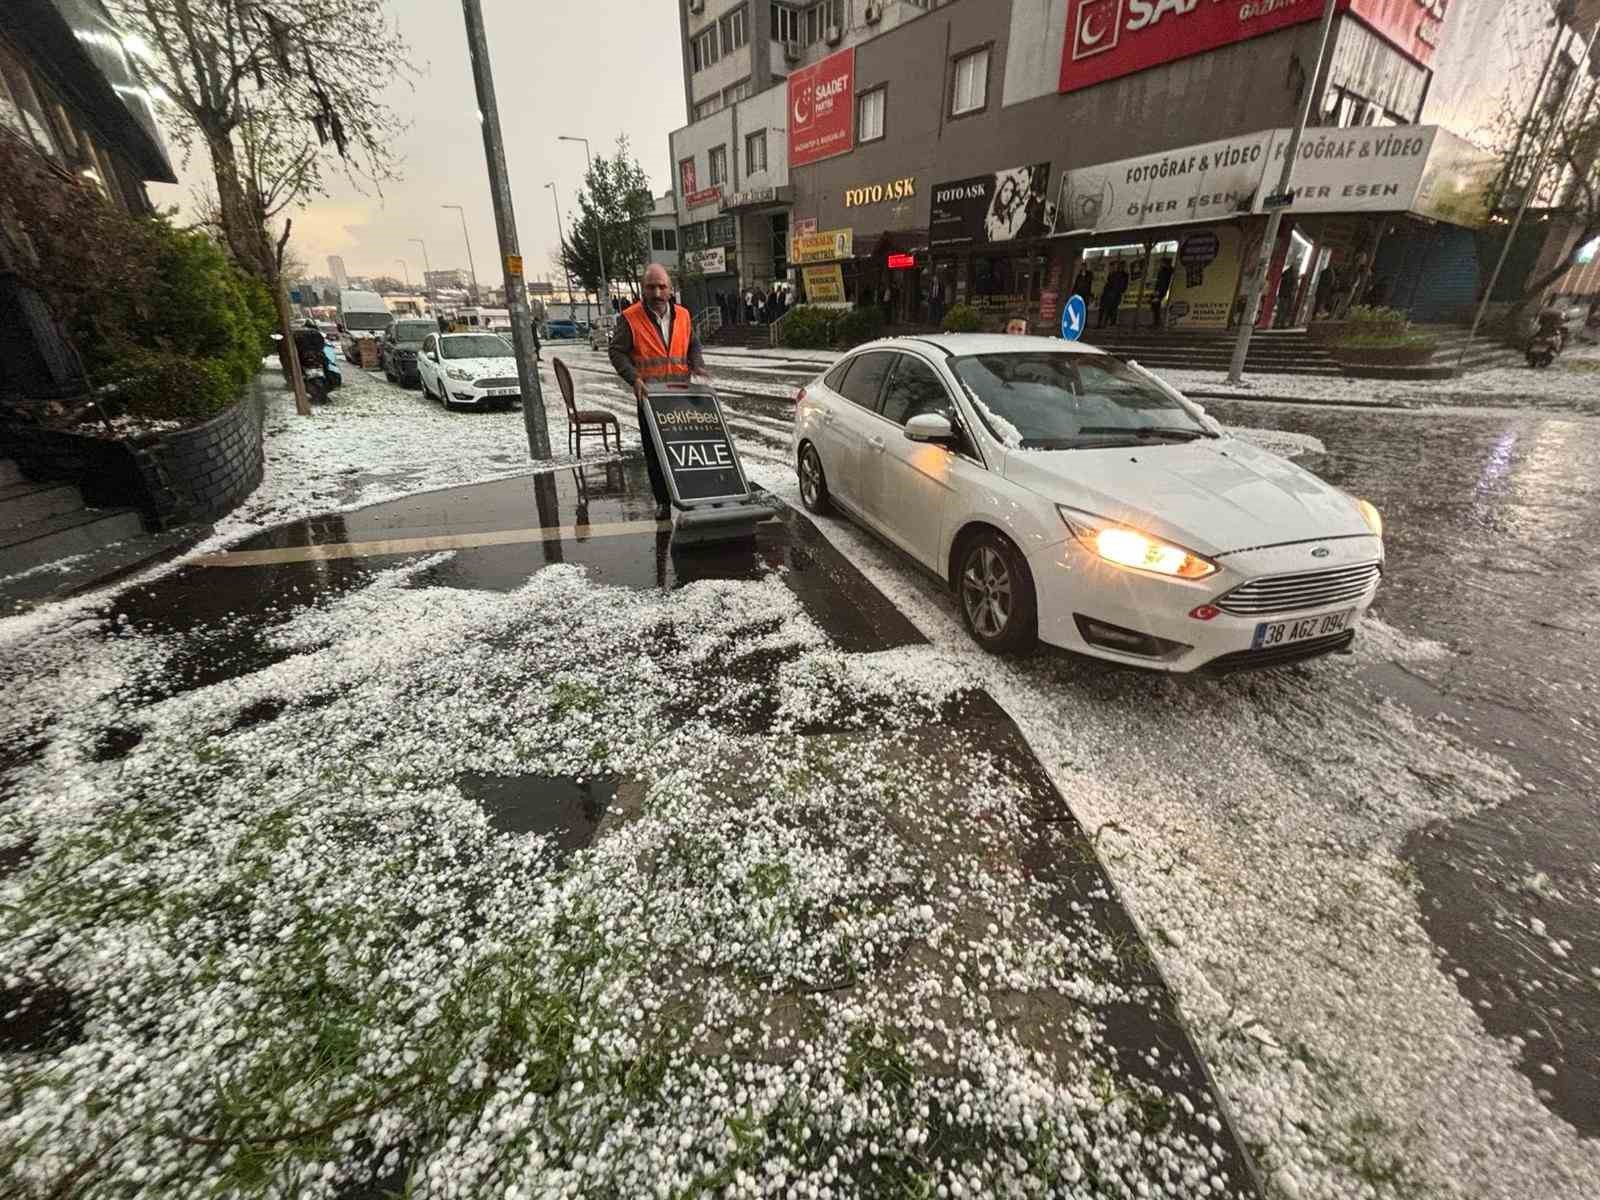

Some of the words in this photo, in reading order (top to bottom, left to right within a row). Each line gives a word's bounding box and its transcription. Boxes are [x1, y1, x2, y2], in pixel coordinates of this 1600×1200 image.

[815, 75, 849, 101] SAADET
[1358, 142, 1370, 158] &
[1375, 133, 1424, 157] VİDEO
[1126, 157, 1196, 184] FOTOĞRAF
[1198, 154, 1209, 172] &
[1214, 144, 1261, 168] VİDEO
[845, 184, 882, 208] FOTO
[936, 189, 964, 203] FOTO
[1342, 184, 1399, 197] ESEN
[1127, 199, 1177, 216] ÖMER
[668, 443, 732, 466] VALE
[1264, 623, 1285, 645] 38
[1288, 619, 1318, 641] AGZ
[1320, 612, 1347, 634] 094
